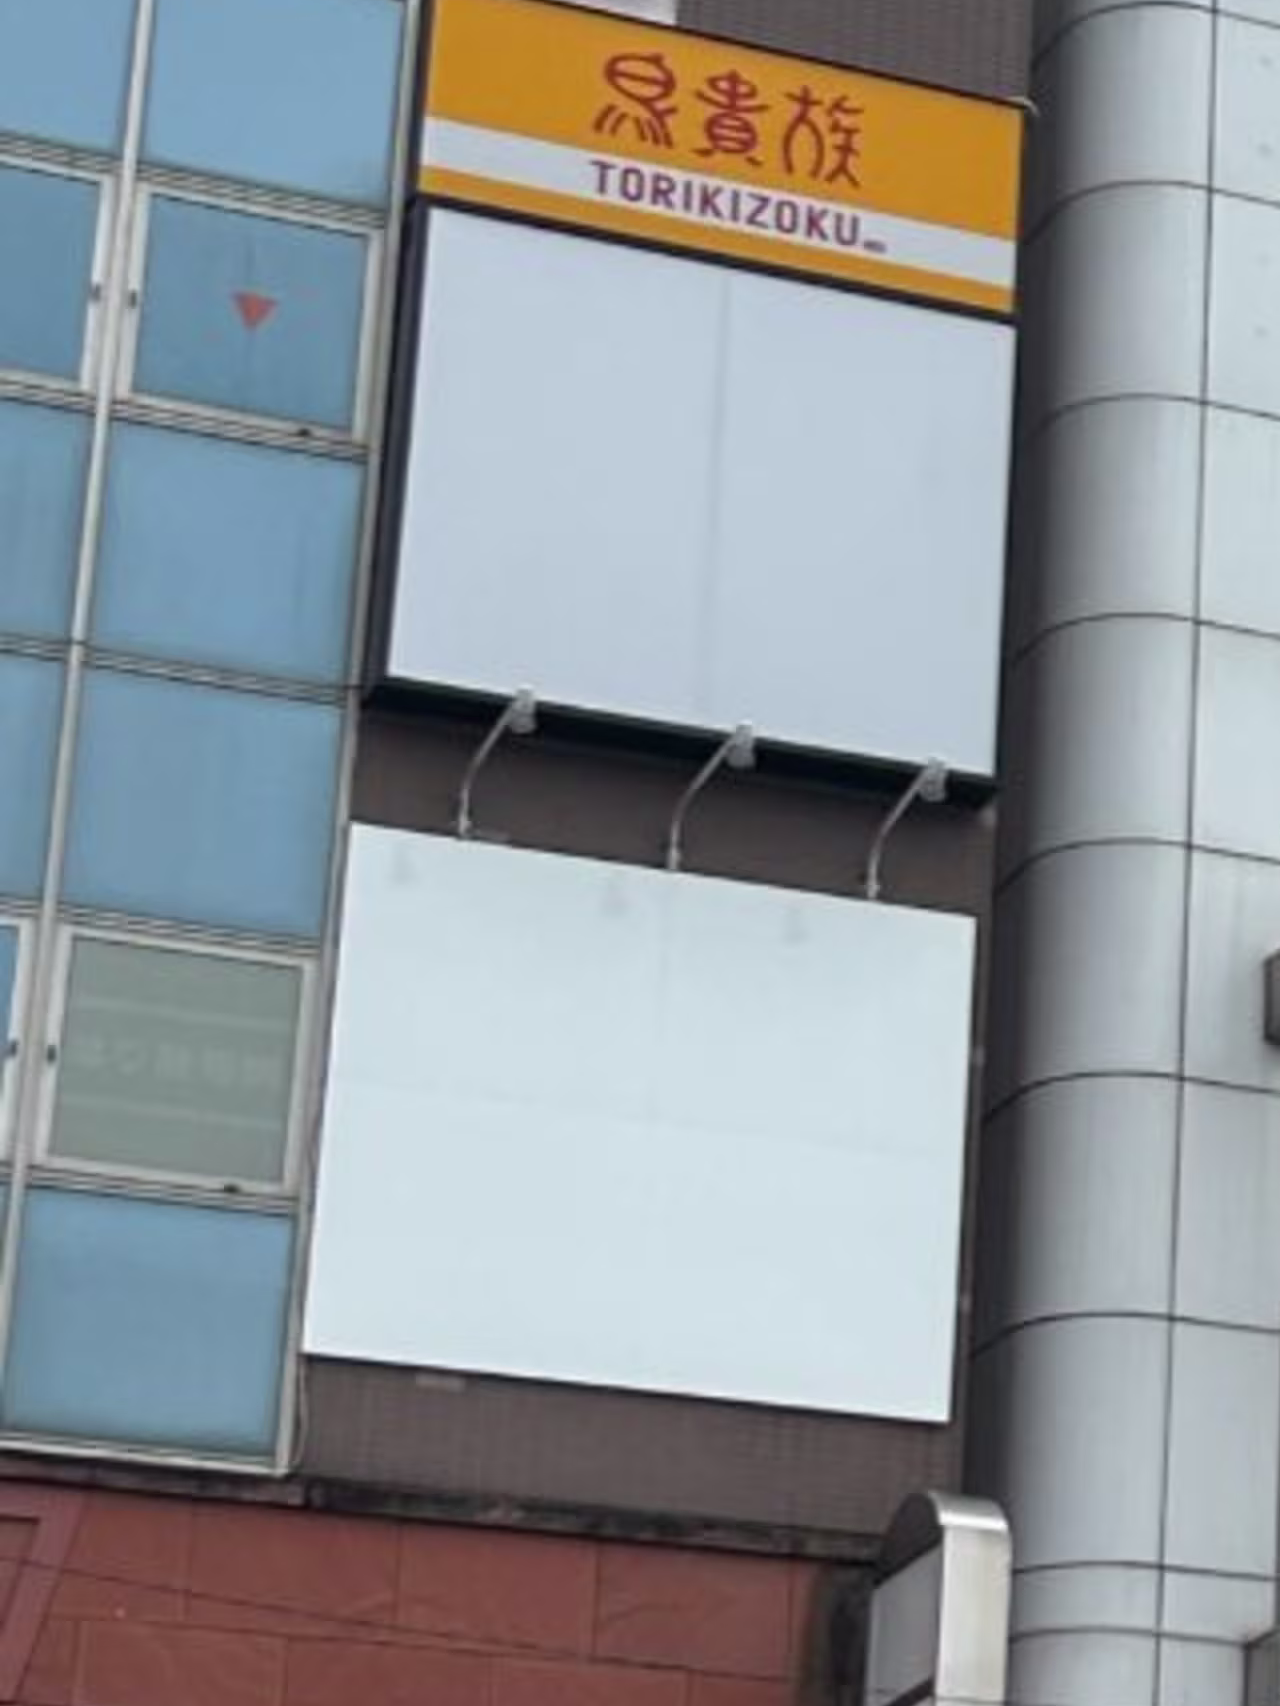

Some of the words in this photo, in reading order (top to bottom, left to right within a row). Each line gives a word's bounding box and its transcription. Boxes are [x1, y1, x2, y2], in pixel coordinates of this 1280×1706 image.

[592, 51, 865, 189] 鳥貴族
[588, 159, 862, 247] TORIKIZOKU
